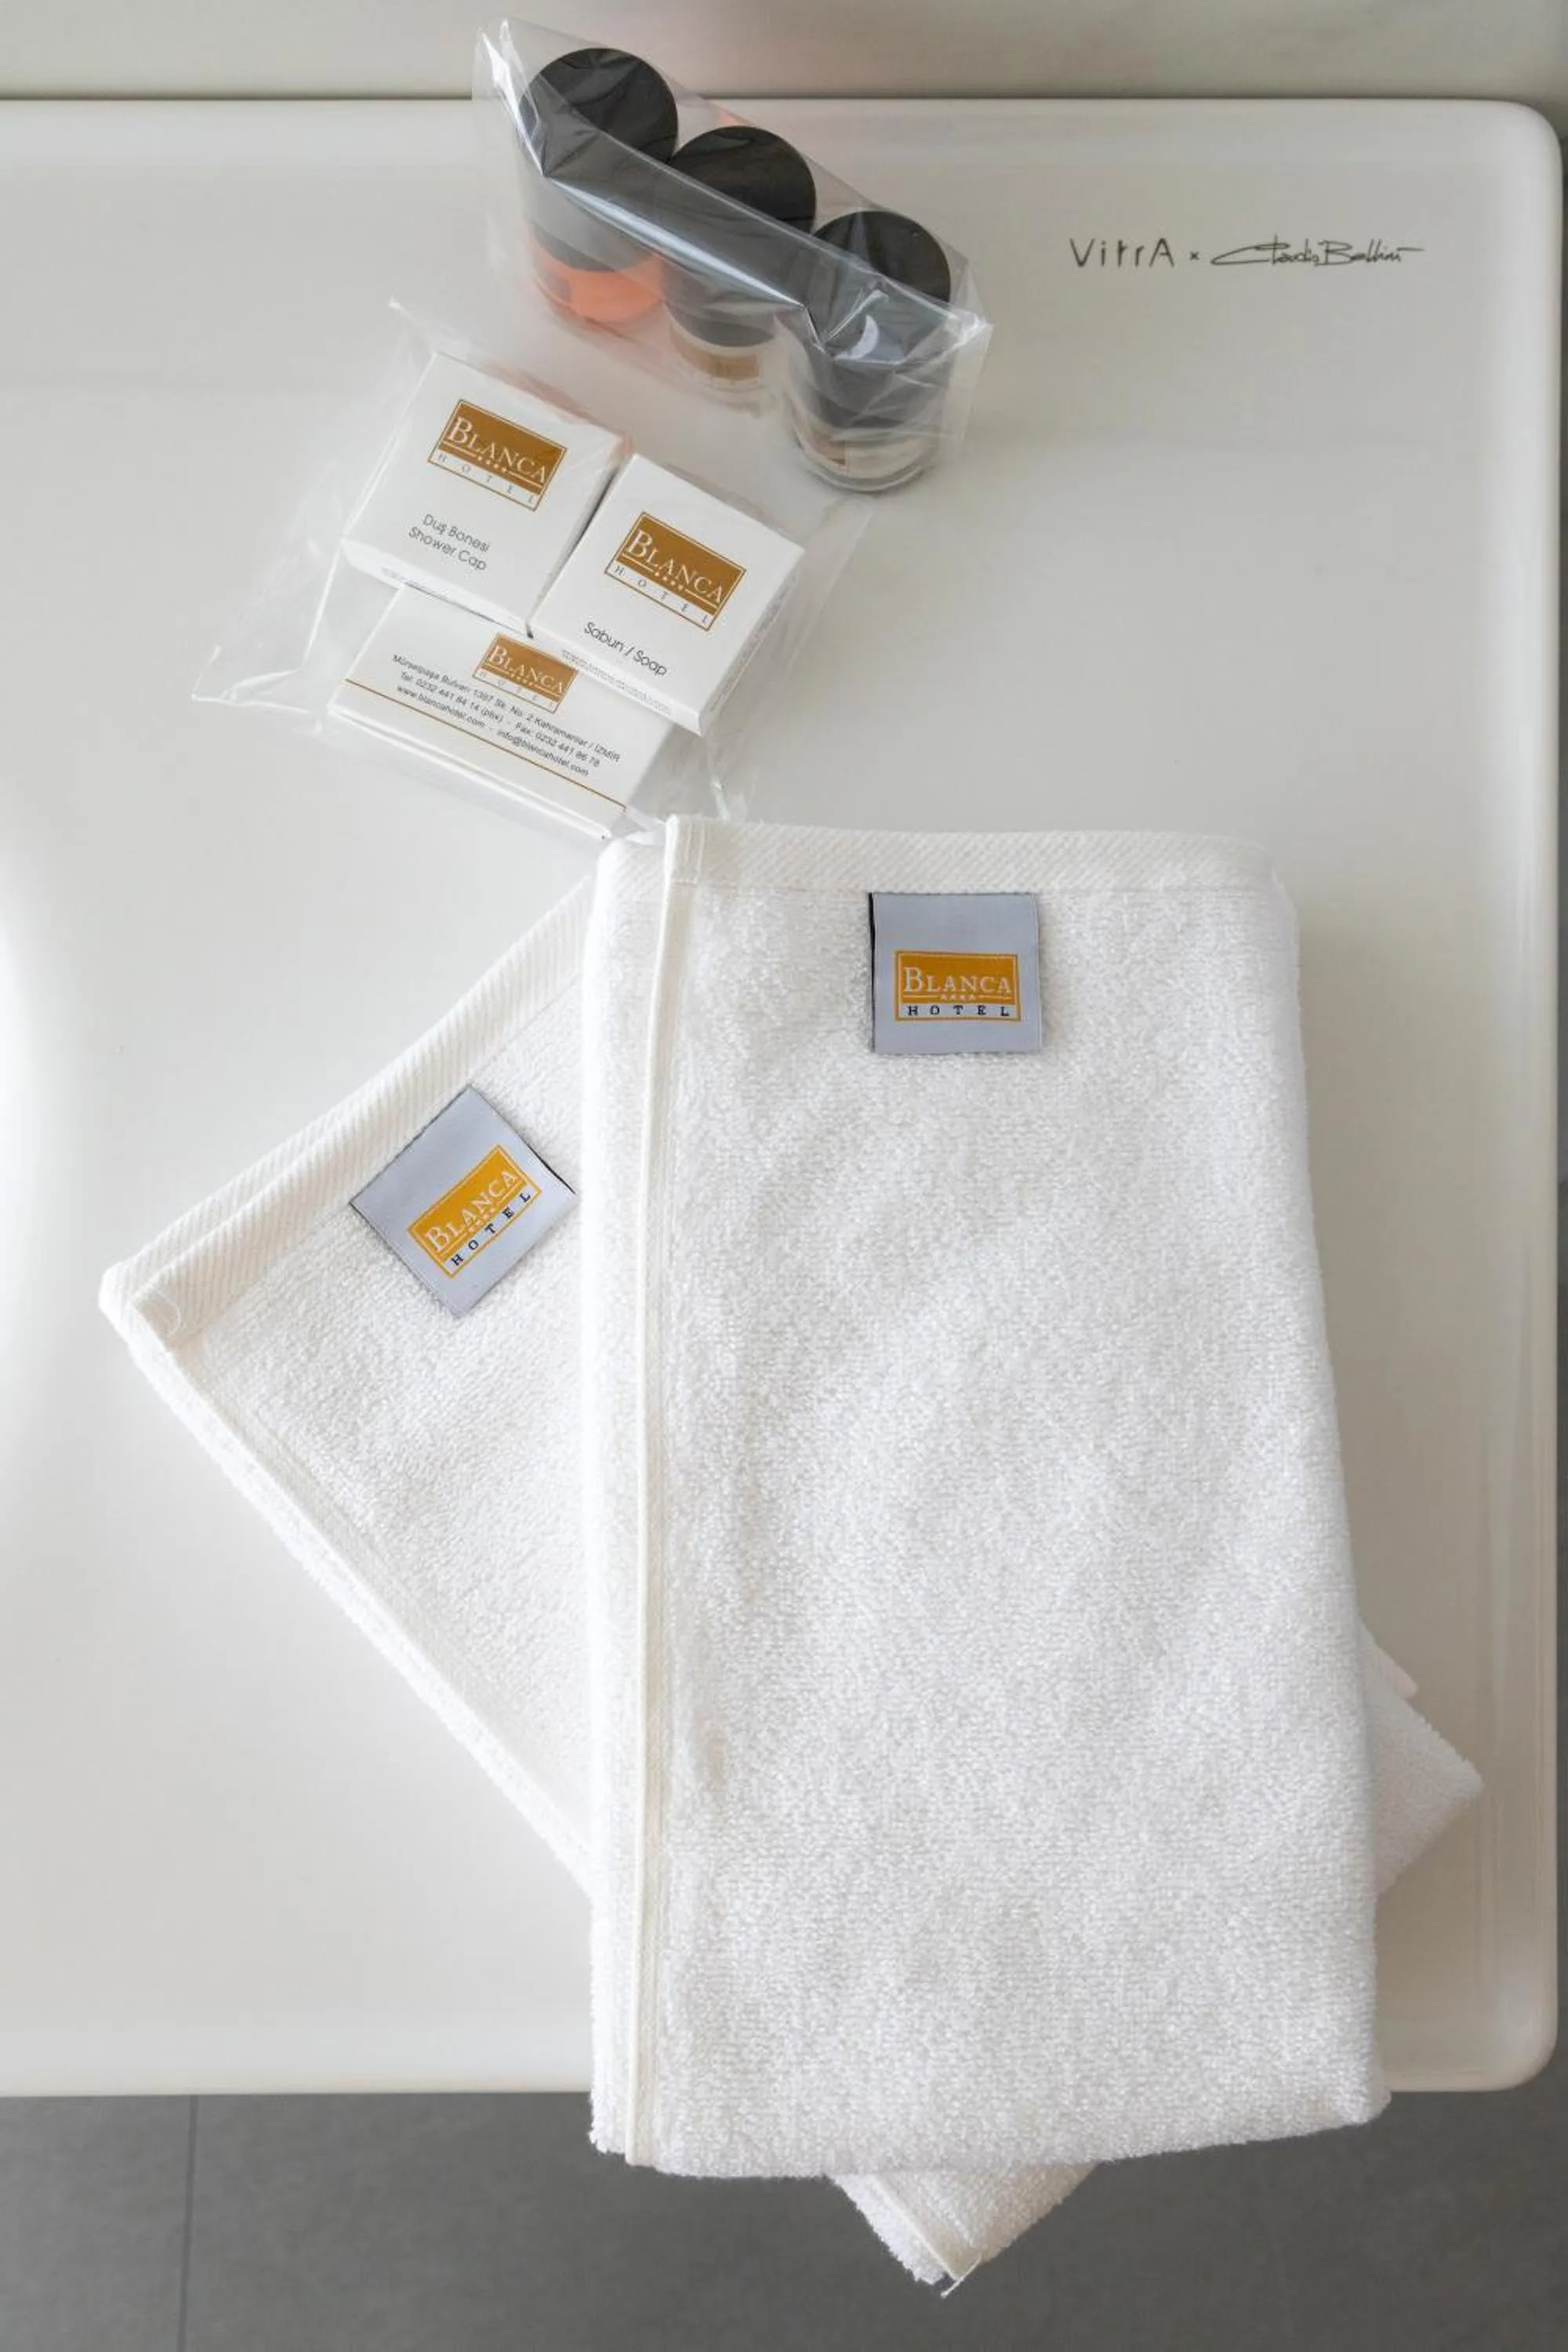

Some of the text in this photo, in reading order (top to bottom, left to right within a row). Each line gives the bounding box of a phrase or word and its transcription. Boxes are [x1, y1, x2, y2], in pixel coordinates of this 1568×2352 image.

[1069, 238, 1175, 269] VitrA
[448, 416, 546, 483] BLANCA
[437, 452, 534, 503] HOTEL
[408, 526, 487, 571] Shower Cap
[626, 528, 724, 604] BLANCA
[614, 565, 709, 623] HOTEL
[488, 644, 563, 694] BLANCA
[584, 622, 625, 652] Sabun
[633, 650, 667, 676] Soap
[902, 966, 1012, 994] BLANCA
[907, 1004, 1011, 1017] HOTEL
[425, 1170, 517, 1253] BLANCA
[451, 1190, 532, 1267] HOTEL
